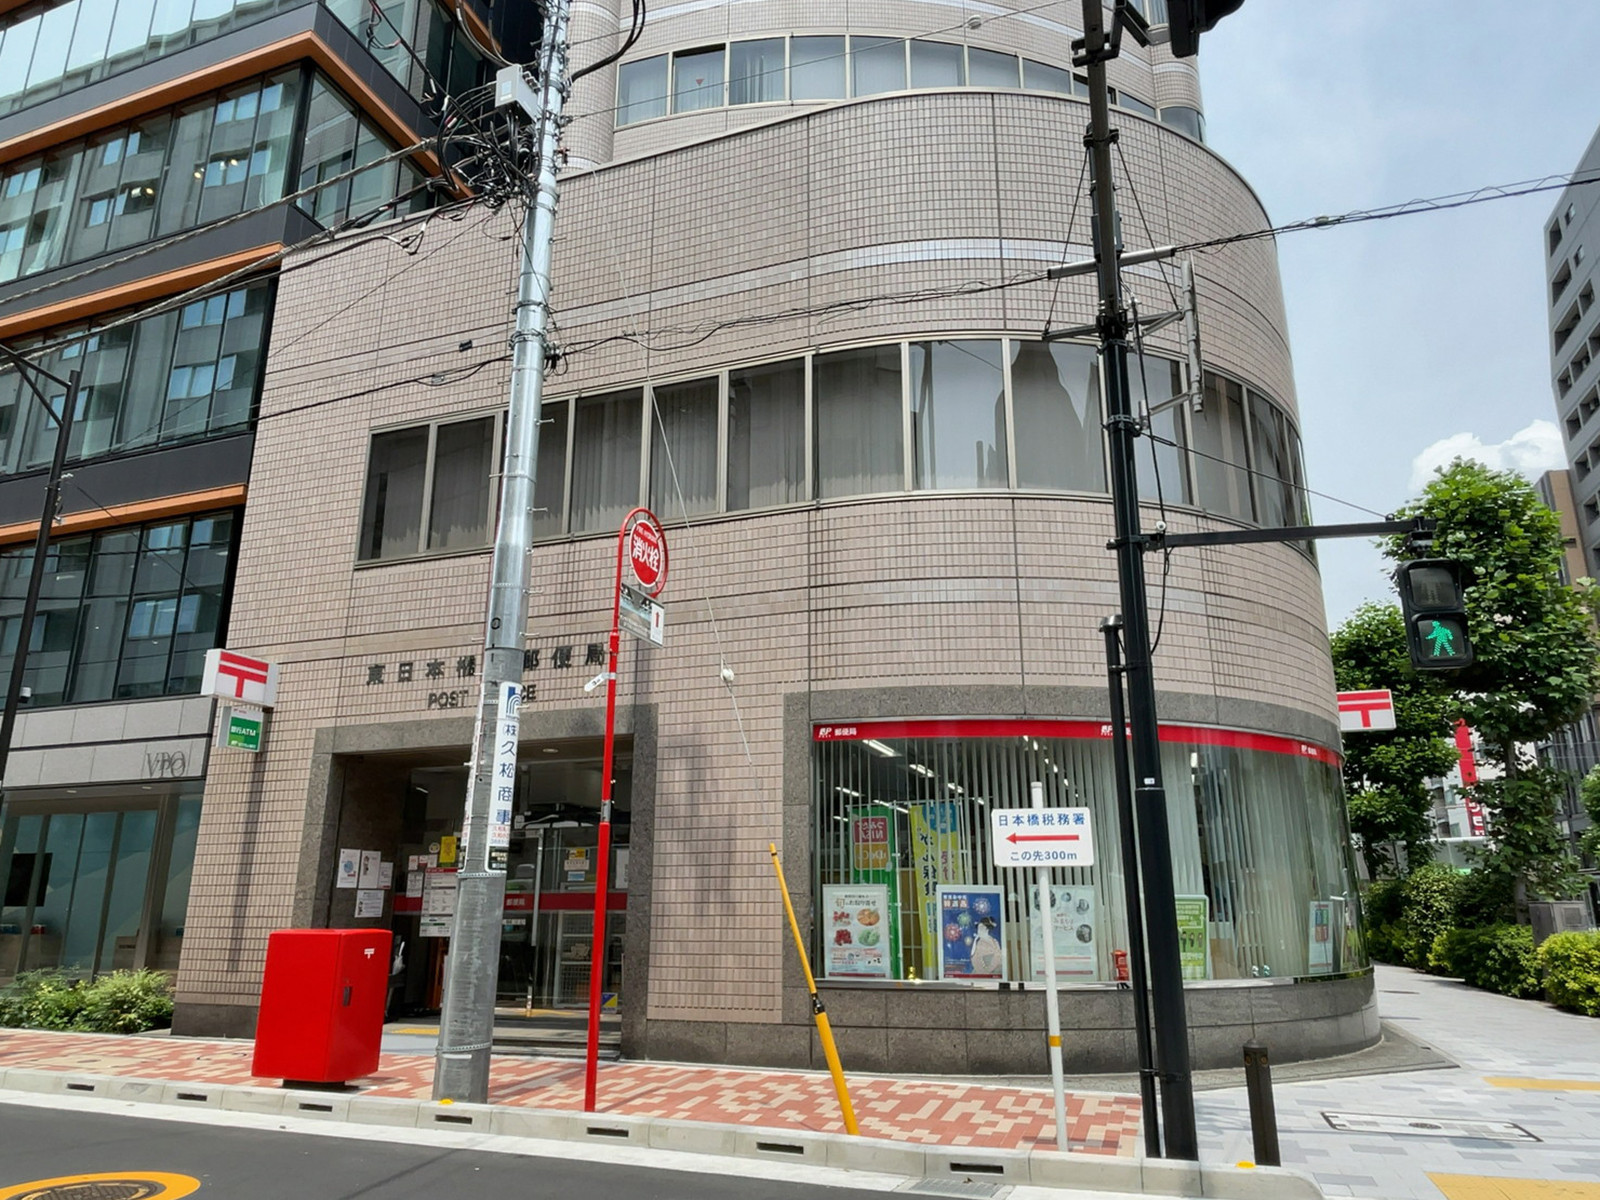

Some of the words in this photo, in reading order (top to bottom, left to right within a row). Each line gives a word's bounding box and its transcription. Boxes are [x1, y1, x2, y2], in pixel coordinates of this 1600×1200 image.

[633, 533, 659, 572] 消火栓
[366, 643, 605, 686] 東日本橋郵便局
[427, 690, 469, 709] POST
[998, 813, 1085, 826] 日本橋税務署
[1010, 850, 1078, 861] この先300m
